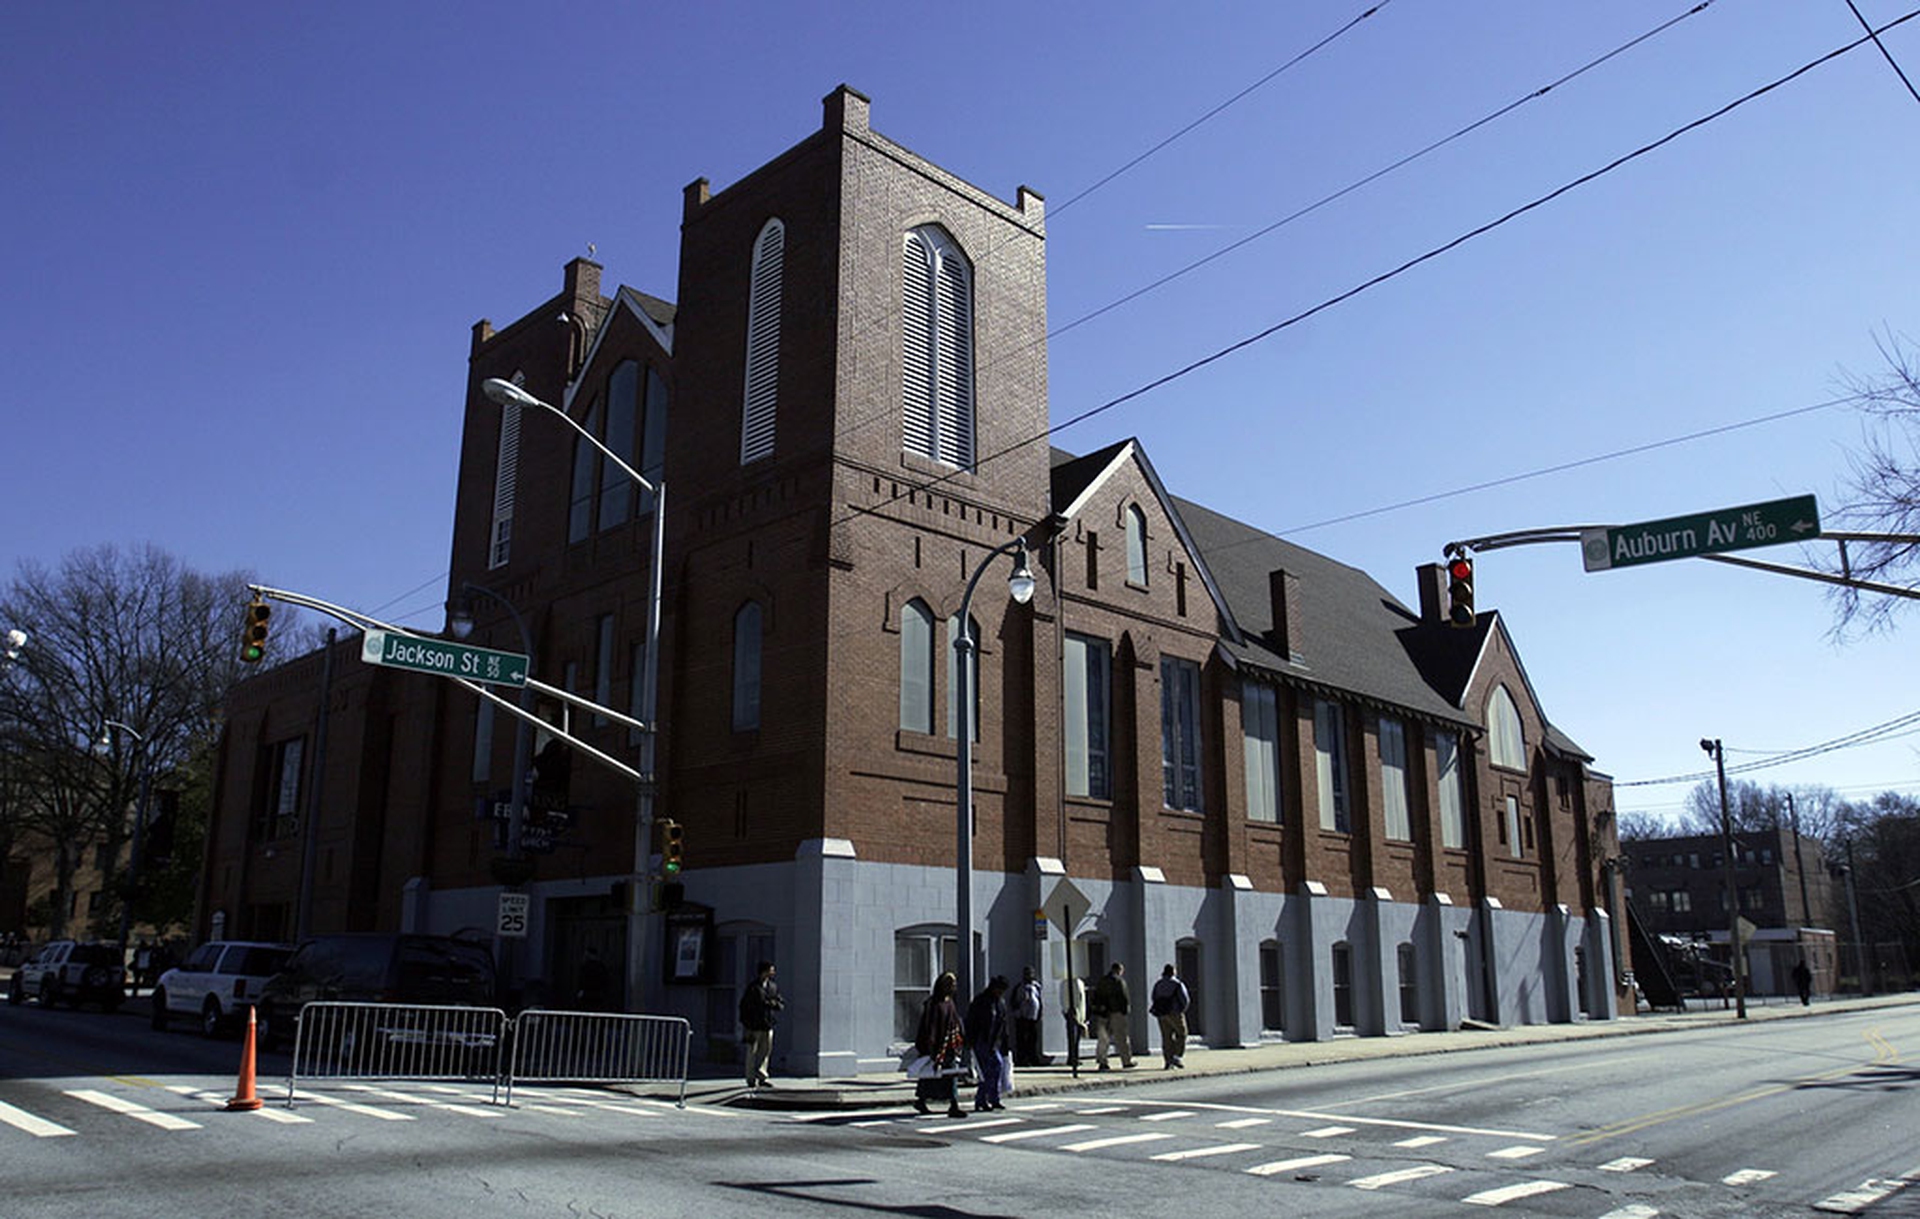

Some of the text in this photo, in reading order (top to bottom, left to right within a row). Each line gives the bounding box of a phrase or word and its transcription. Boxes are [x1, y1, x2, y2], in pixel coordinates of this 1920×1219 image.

[1742, 511, 1762, 526] NE
[1615, 519, 1737, 560] Auburn Av
[1746, 523, 1777, 541] 400
[386, 640, 480, 674] Jackson St
[501, 914, 524, 932] 25
